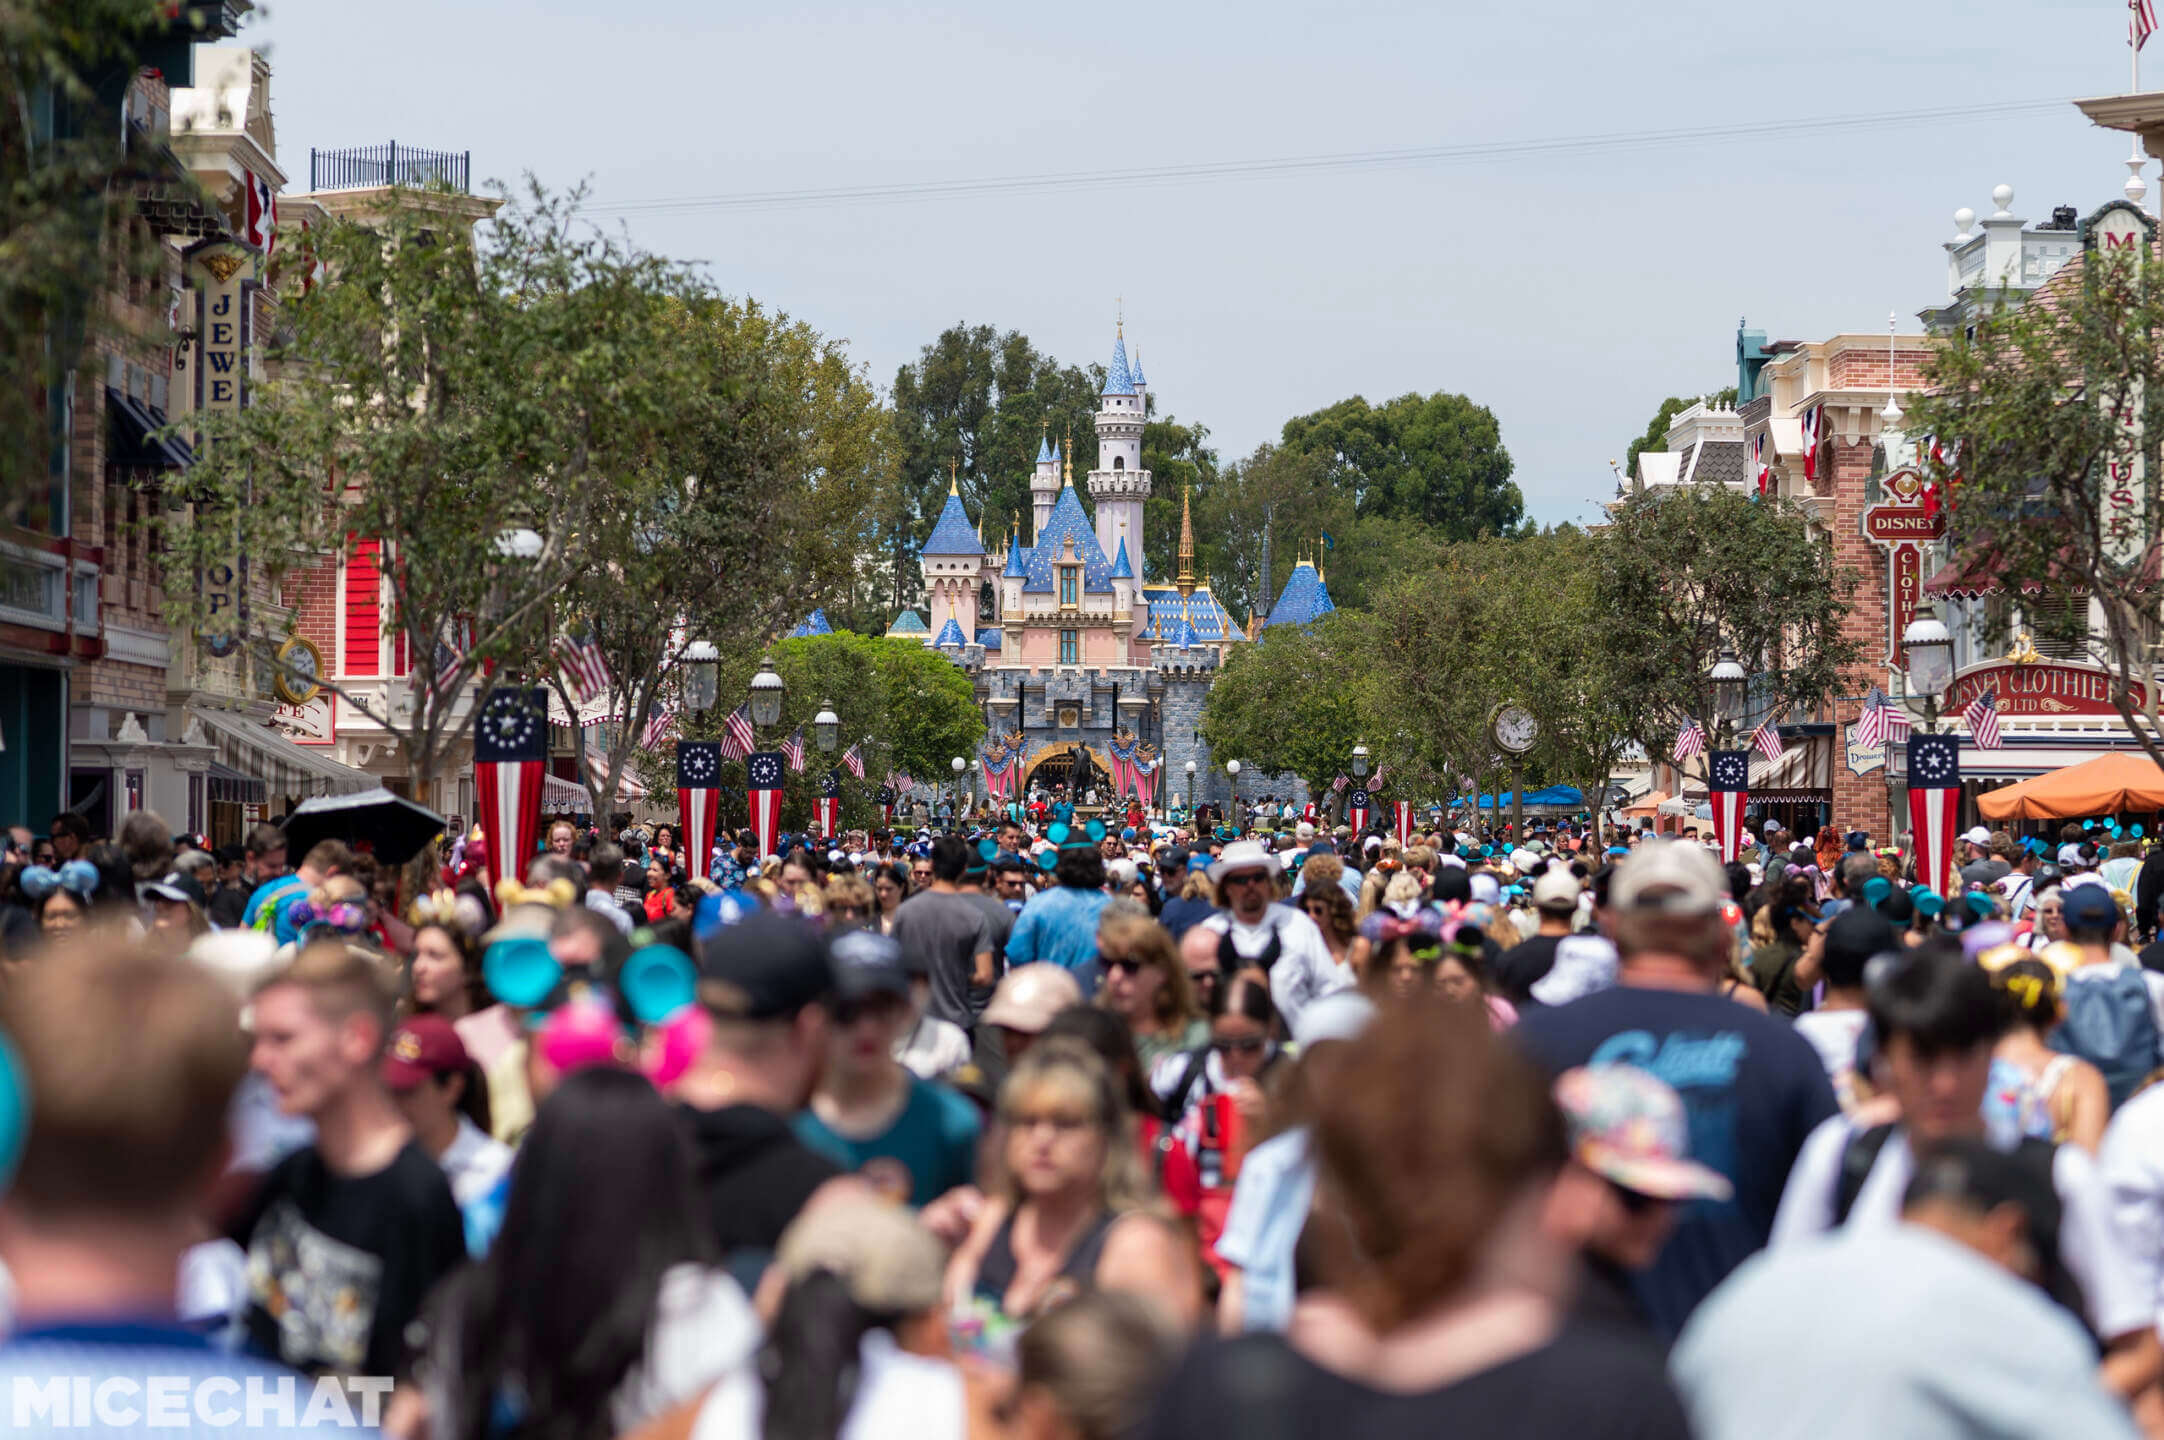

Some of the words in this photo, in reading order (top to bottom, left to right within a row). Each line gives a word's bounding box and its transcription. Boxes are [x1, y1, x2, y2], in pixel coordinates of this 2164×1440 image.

[1875, 517, 1935, 530] DISNEY
[1900, 551, 1913, 658] CLOTHI
[2014, 698, 2038, 712] LTD
